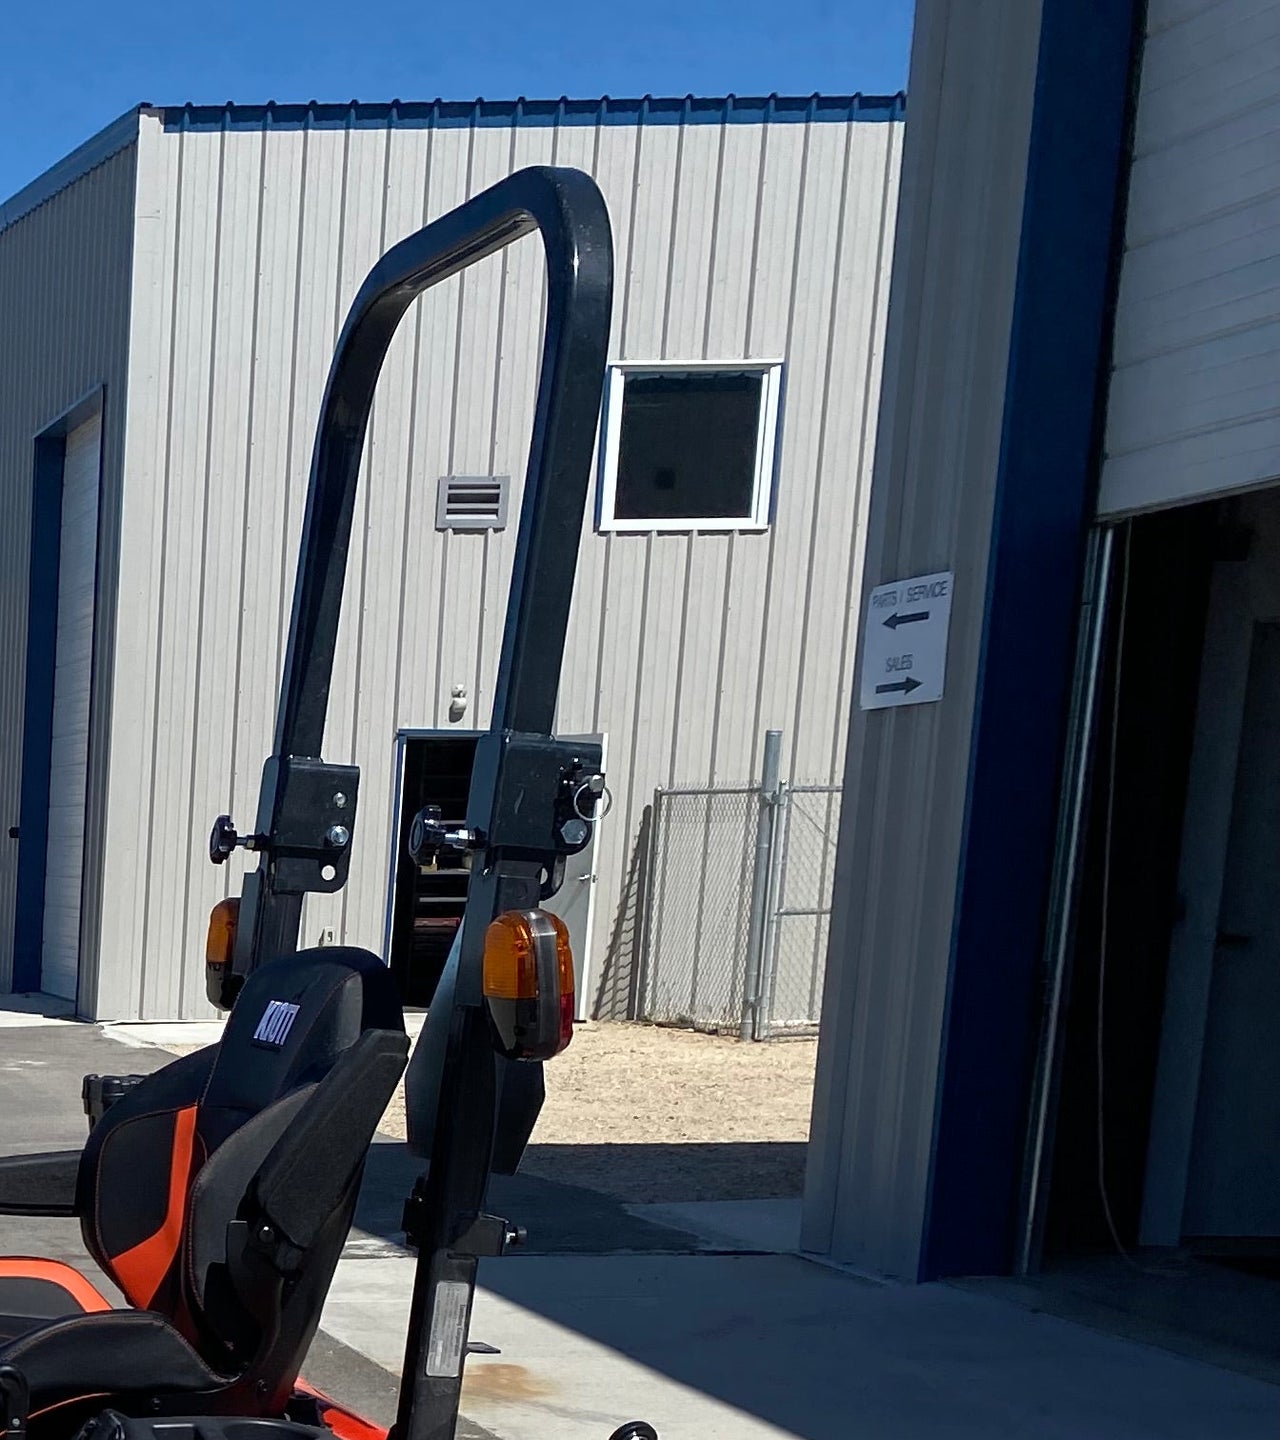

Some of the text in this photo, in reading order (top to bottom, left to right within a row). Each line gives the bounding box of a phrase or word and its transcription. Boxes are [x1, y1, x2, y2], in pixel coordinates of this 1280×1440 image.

[872, 590, 897, 608] PARTS
[906, 580, 948, 604] SERVICE
[885, 654, 913, 673] SALES
[253, 1000, 300, 1046] KIOTI
